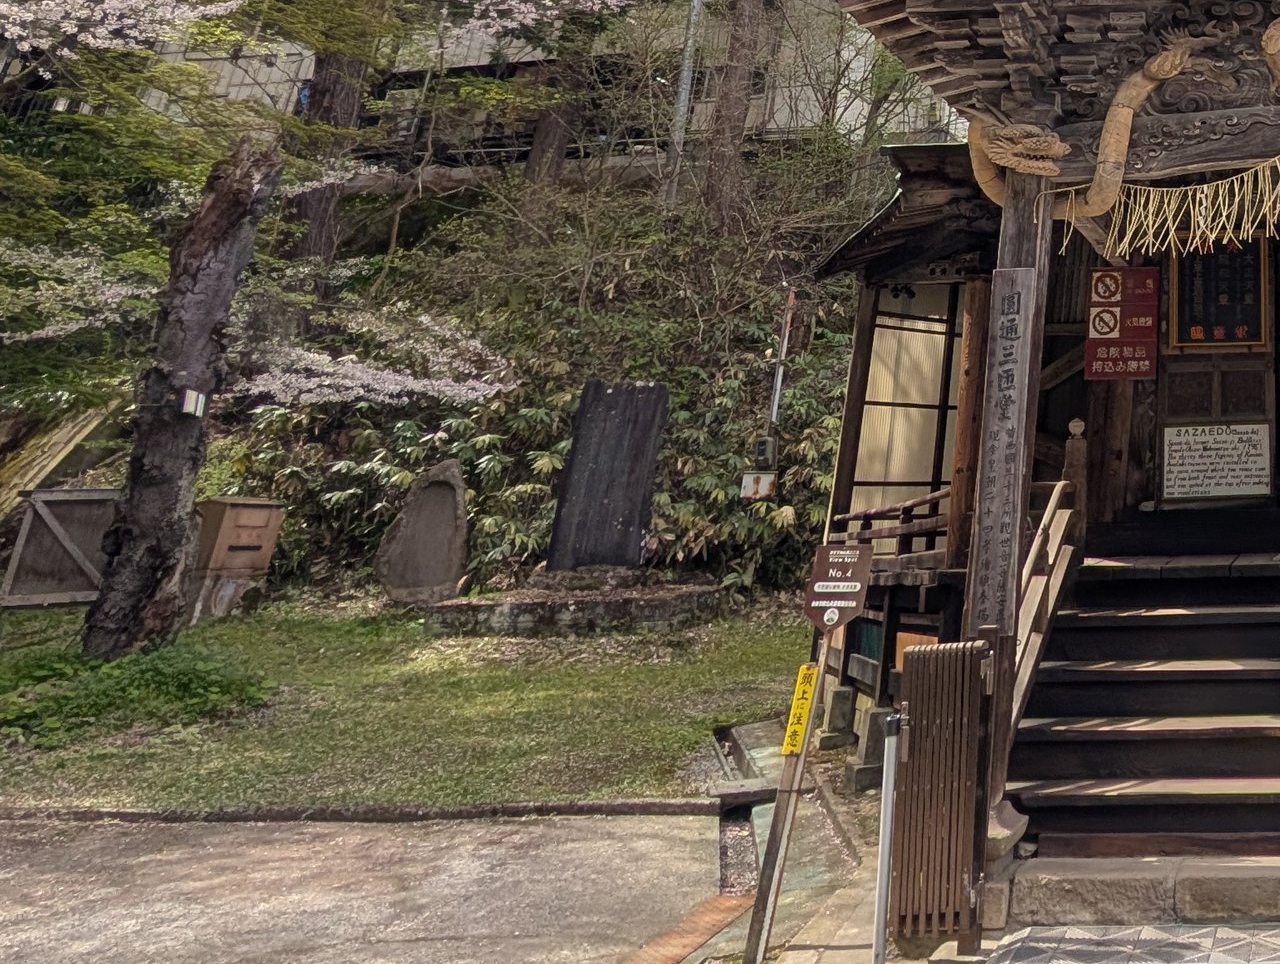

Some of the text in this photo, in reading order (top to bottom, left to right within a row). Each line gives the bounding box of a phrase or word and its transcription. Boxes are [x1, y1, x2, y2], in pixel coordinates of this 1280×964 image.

[828, 568, 852, 578] No.4
[786, 672, 814, 748] 頭上に注意
